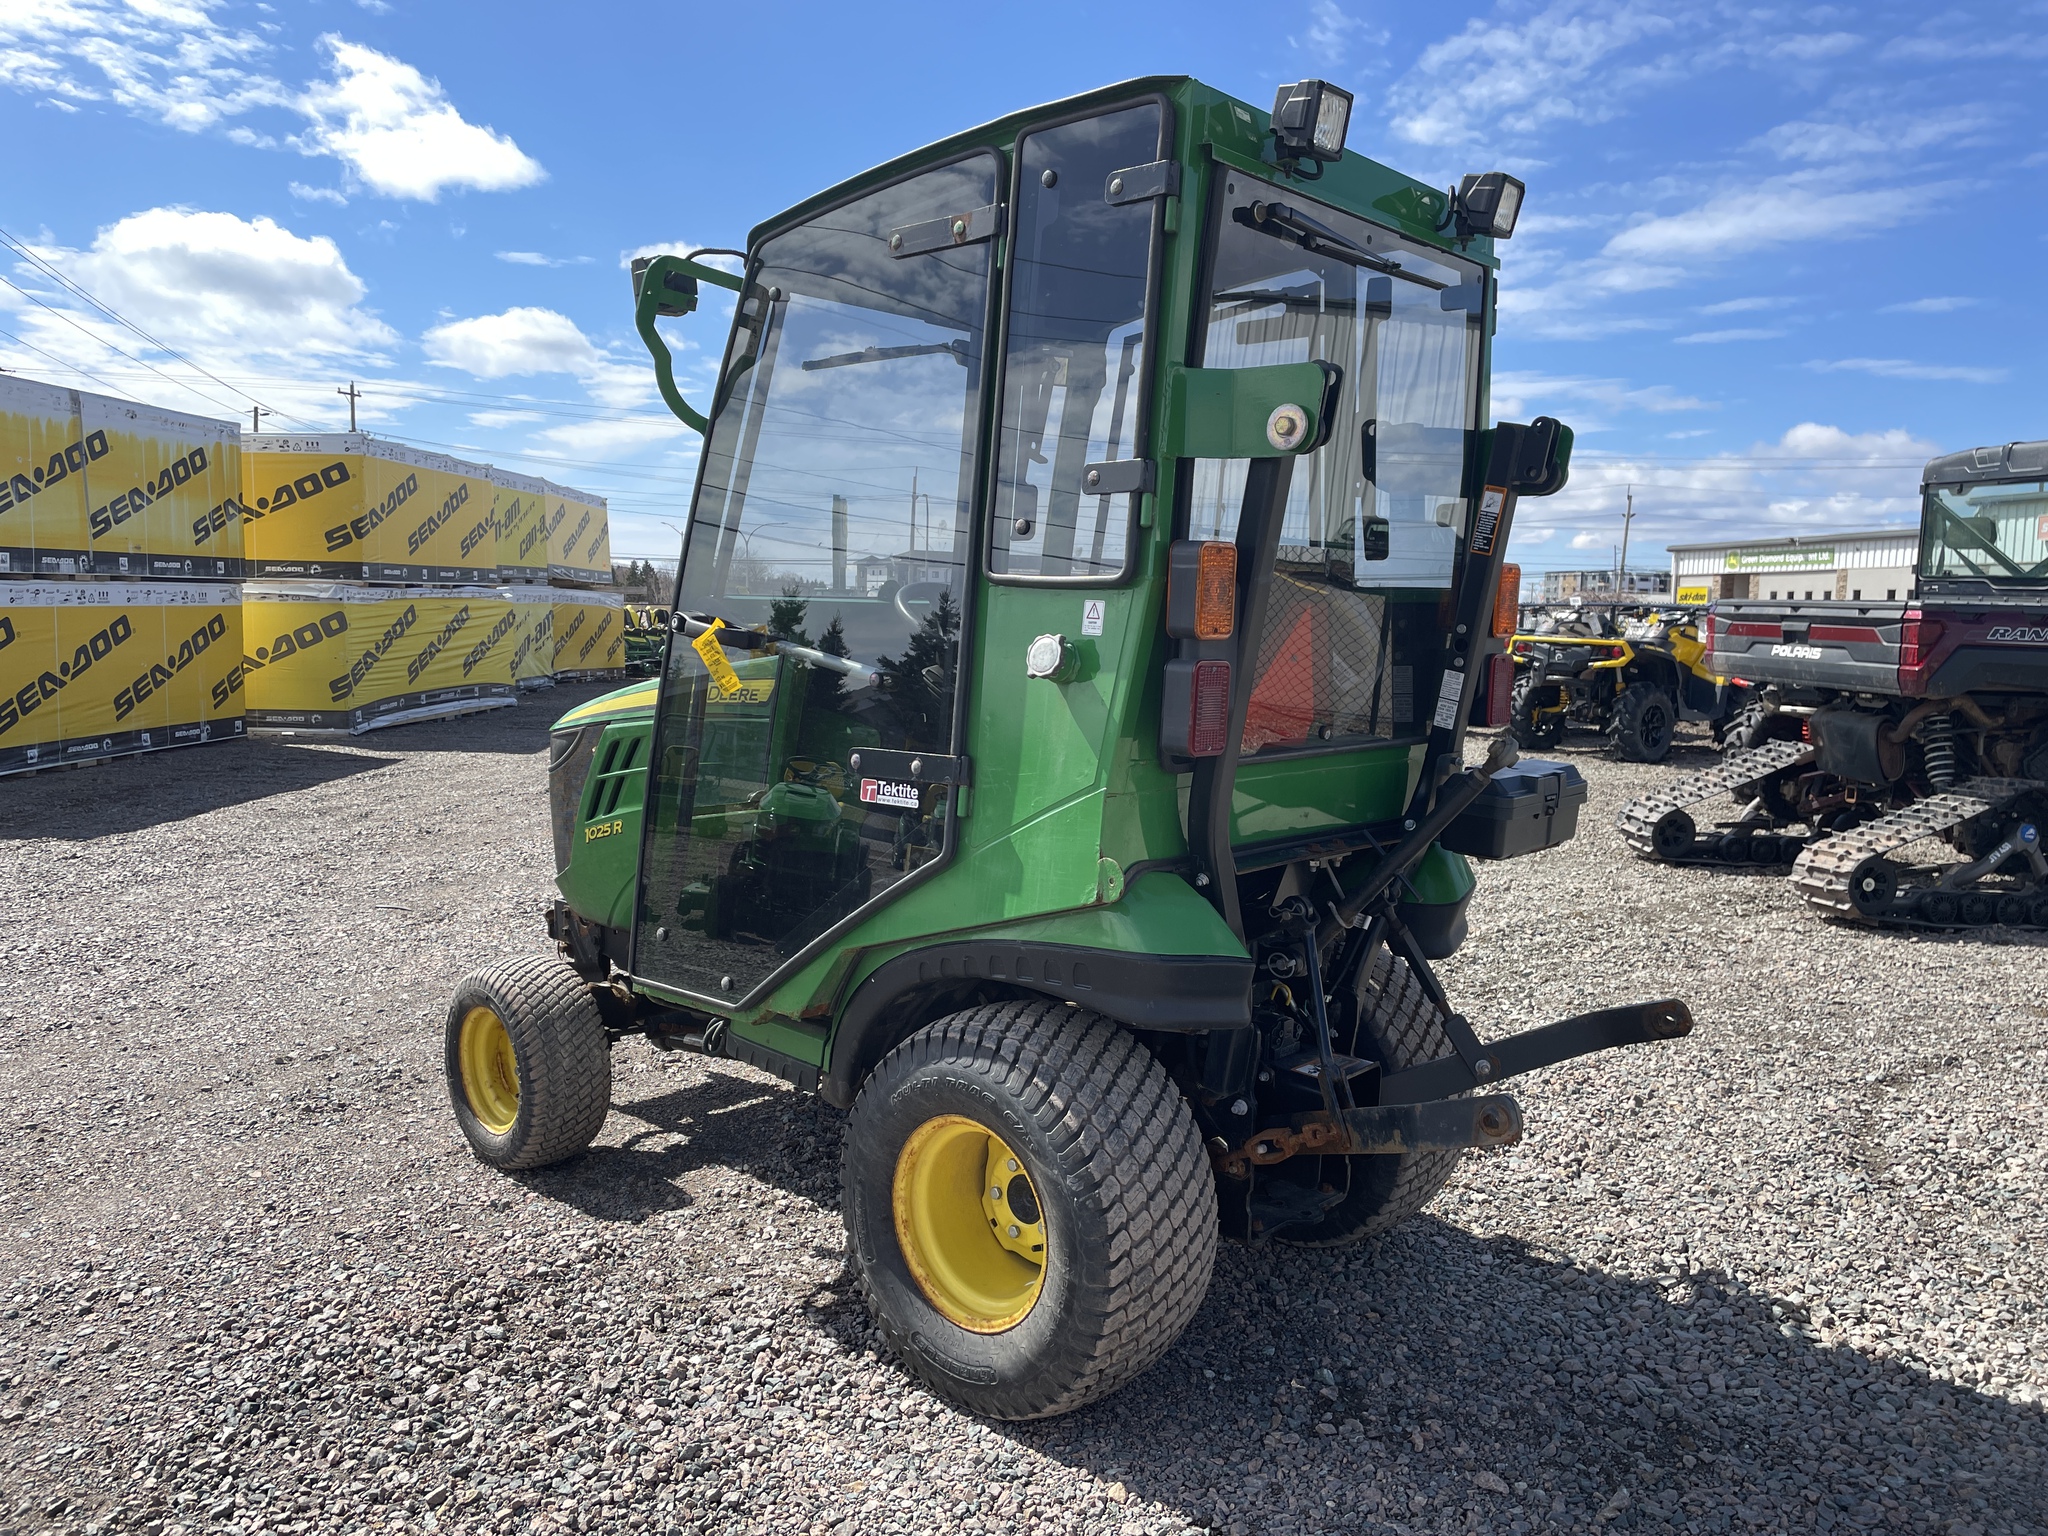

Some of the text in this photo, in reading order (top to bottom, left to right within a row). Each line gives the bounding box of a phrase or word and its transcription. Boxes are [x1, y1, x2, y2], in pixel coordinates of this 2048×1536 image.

[1741, 556, 1758, 564] Green
[1759, 554, 1785, 563] Diamond
[1785, 552, 1817, 564] Equipent
[1771, 644, 1822, 660] POLARIS
[878, 780, 919, 799] Tektite
[585, 820, 623, 844] 1025 R
[890, 1076, 938, 1107] MULTI
[945, 1076, 997, 1105] TRAC
